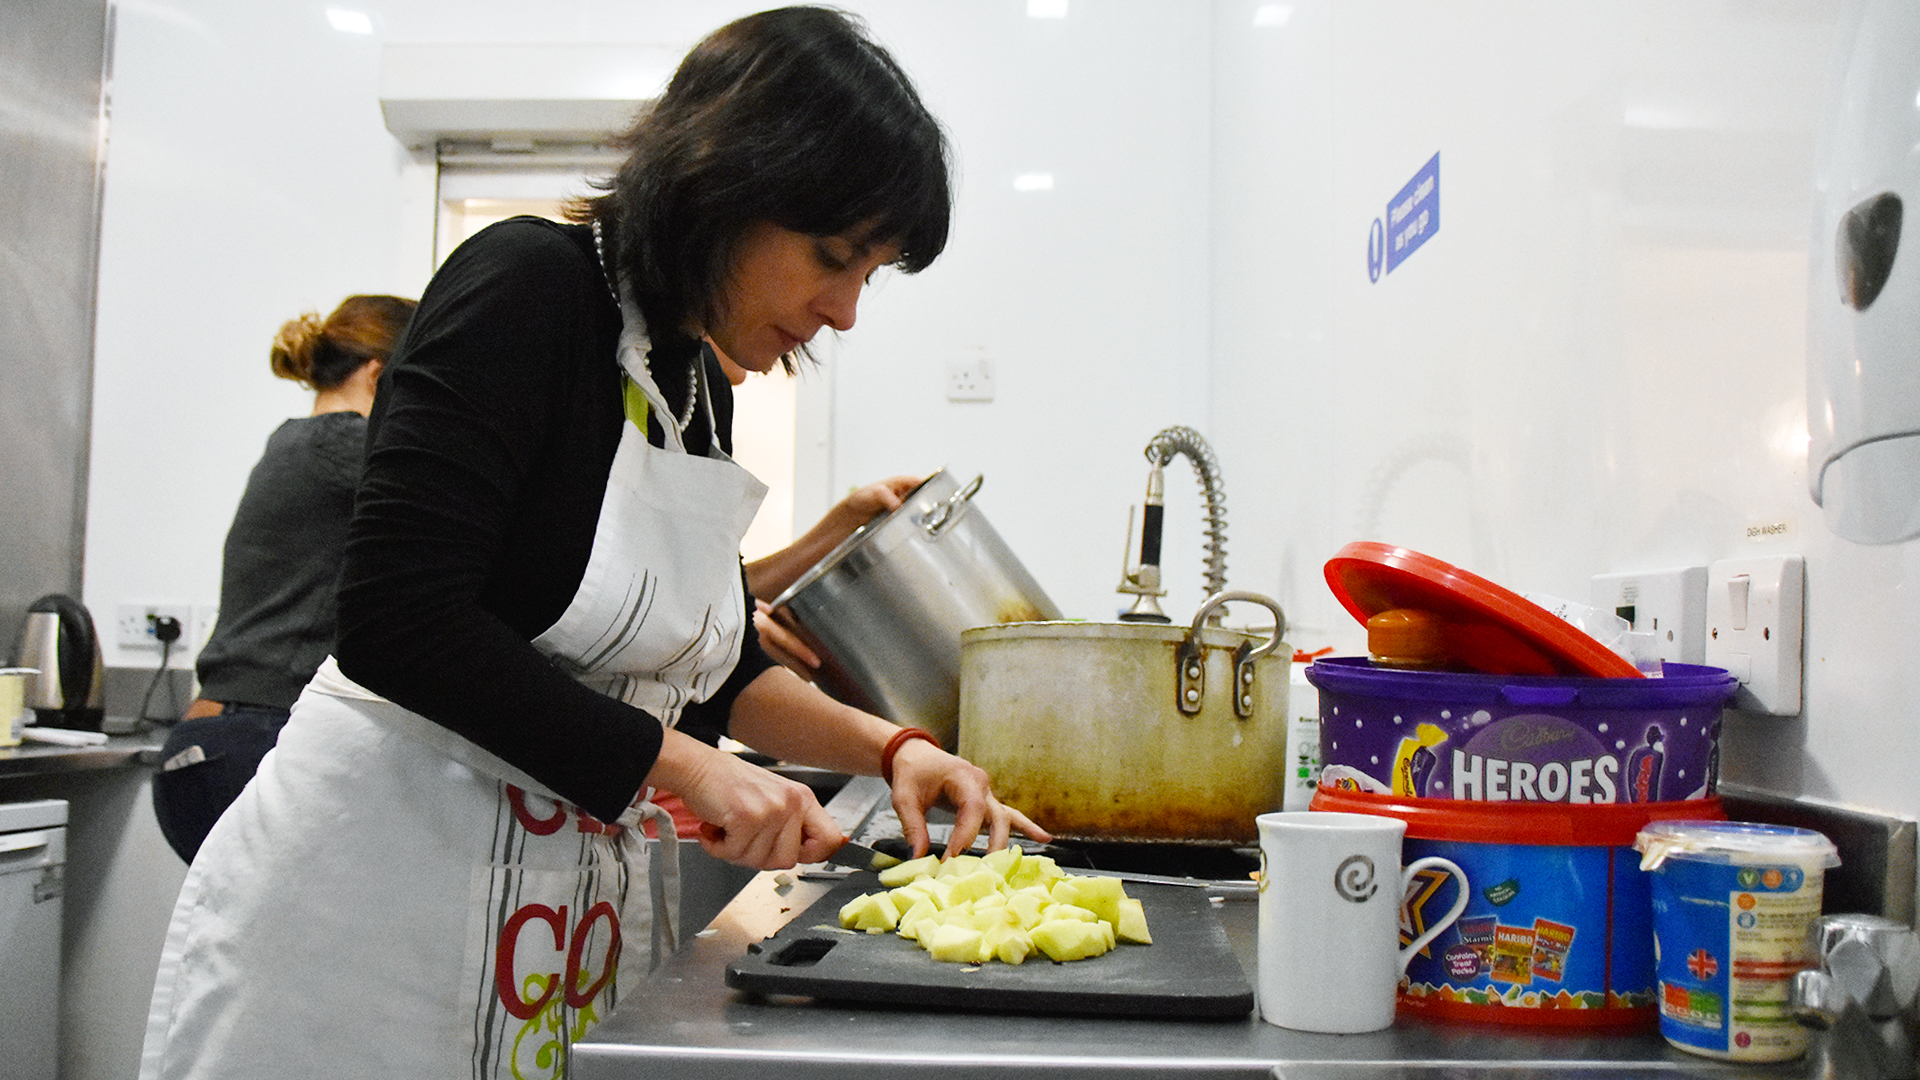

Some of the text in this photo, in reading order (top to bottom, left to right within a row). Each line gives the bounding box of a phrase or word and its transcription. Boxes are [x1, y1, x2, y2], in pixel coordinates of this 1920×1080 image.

[1453, 749, 1619, 804] HEROES
[1499, 932, 1533, 945] HARIBO
[1537, 926, 1570, 942] HARIBO
[1446, 952, 1477, 961] Contains
